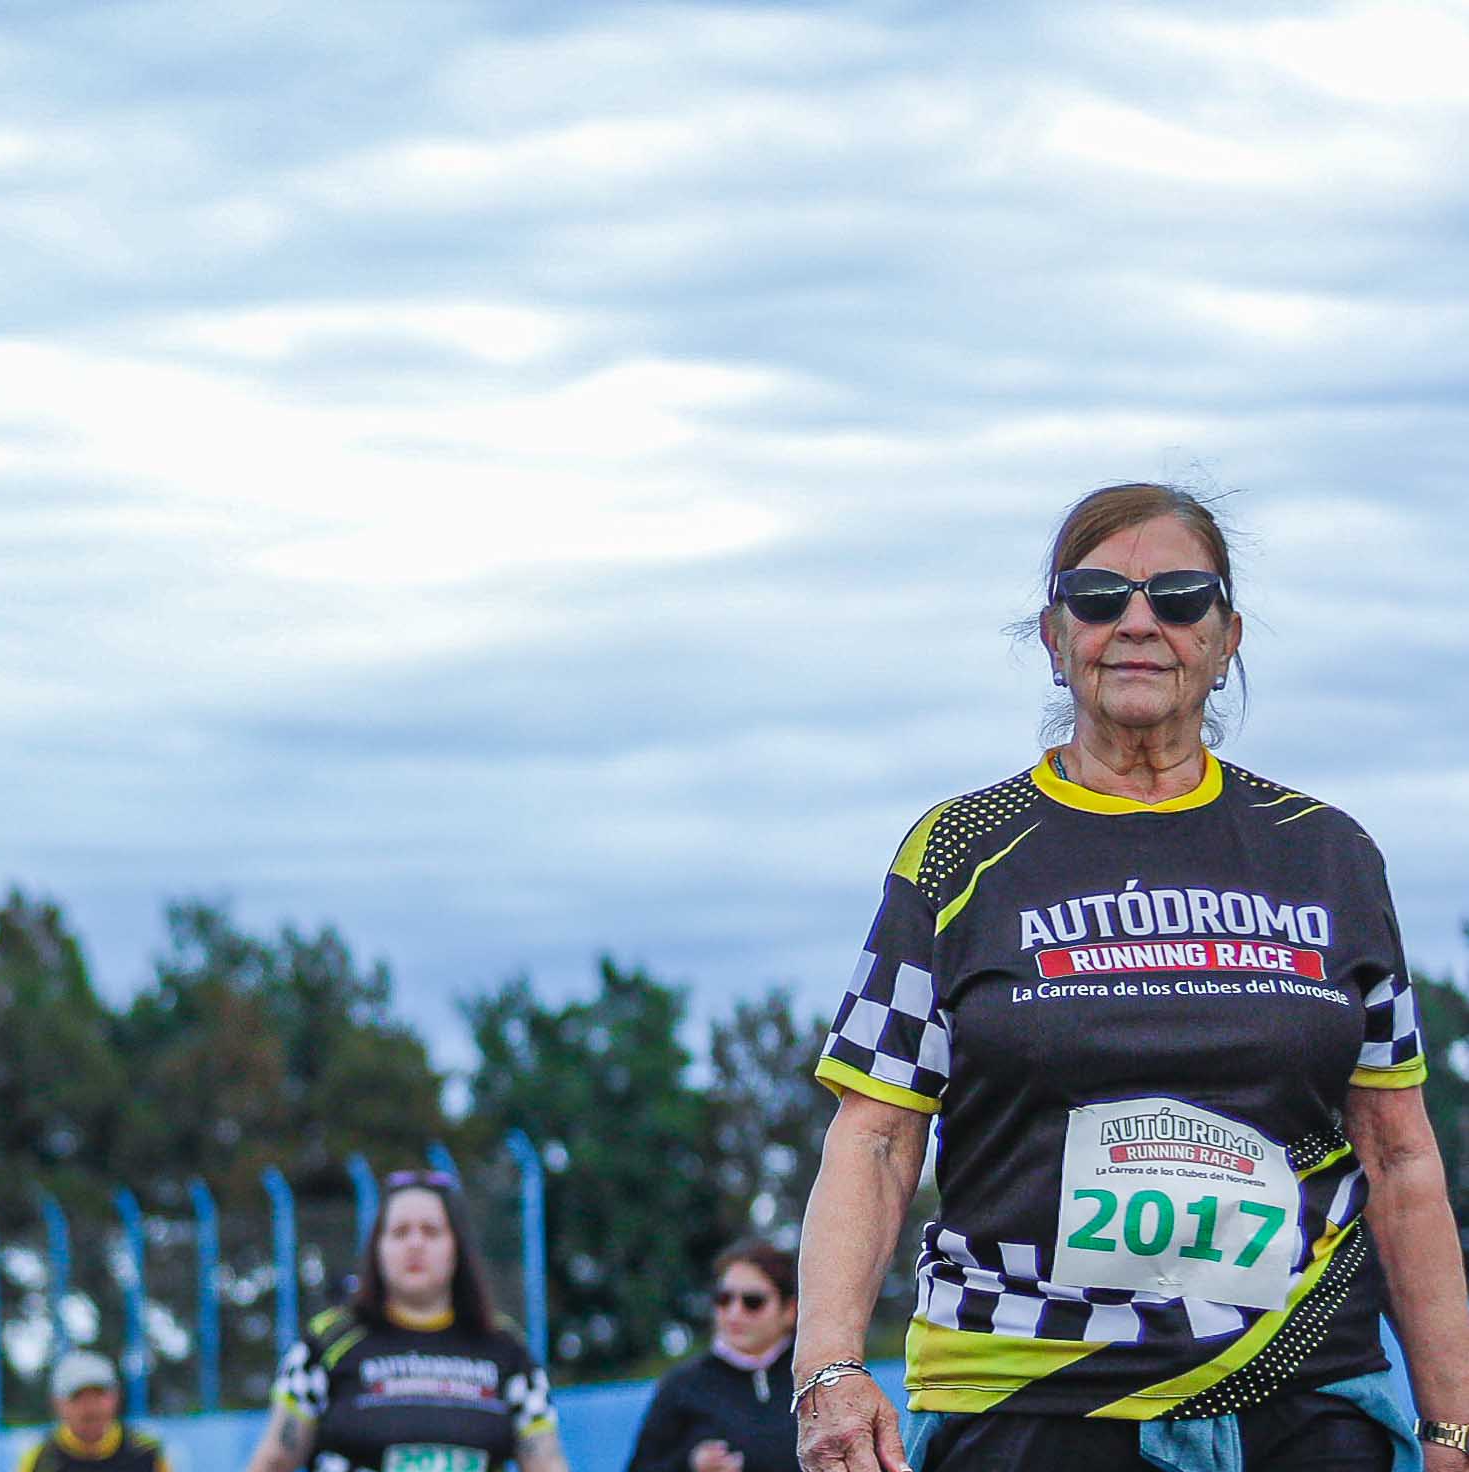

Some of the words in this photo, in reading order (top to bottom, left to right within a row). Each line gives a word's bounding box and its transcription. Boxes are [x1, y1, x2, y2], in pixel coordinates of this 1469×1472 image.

[1019, 879, 1329, 951] AUTÓDROMO
[1068, 943, 1206, 972] RUNNING
[1216, 943, 1295, 972] RACE
[1012, 986, 1032, 1003] La
[1037, 982, 1108, 999] Carrera
[1113, 981, 1139, 996] de
[1143, 980, 1171, 996] los
[1174, 980, 1242, 996] Clubes
[1245, 979, 1275, 994] del
[1281, 980, 1351, 1006] Noroeste
[1100, 1107, 1264, 1160] AUTÓDROMO
[1125, 1144, 1195, 1161] RUNNING
[1199, 1147, 1240, 1170] RACE
[1096, 1167, 1107, 1176] La
[1109, 1165, 1143, 1175] Carrera
[1146, 1166, 1158, 1176] de
[1160, 1167, 1174, 1176] los
[1176, 1168, 1208, 1179] Clubes
[1211, 1171, 1224, 1181] del
[1067, 1189, 1286, 1268] 2017
